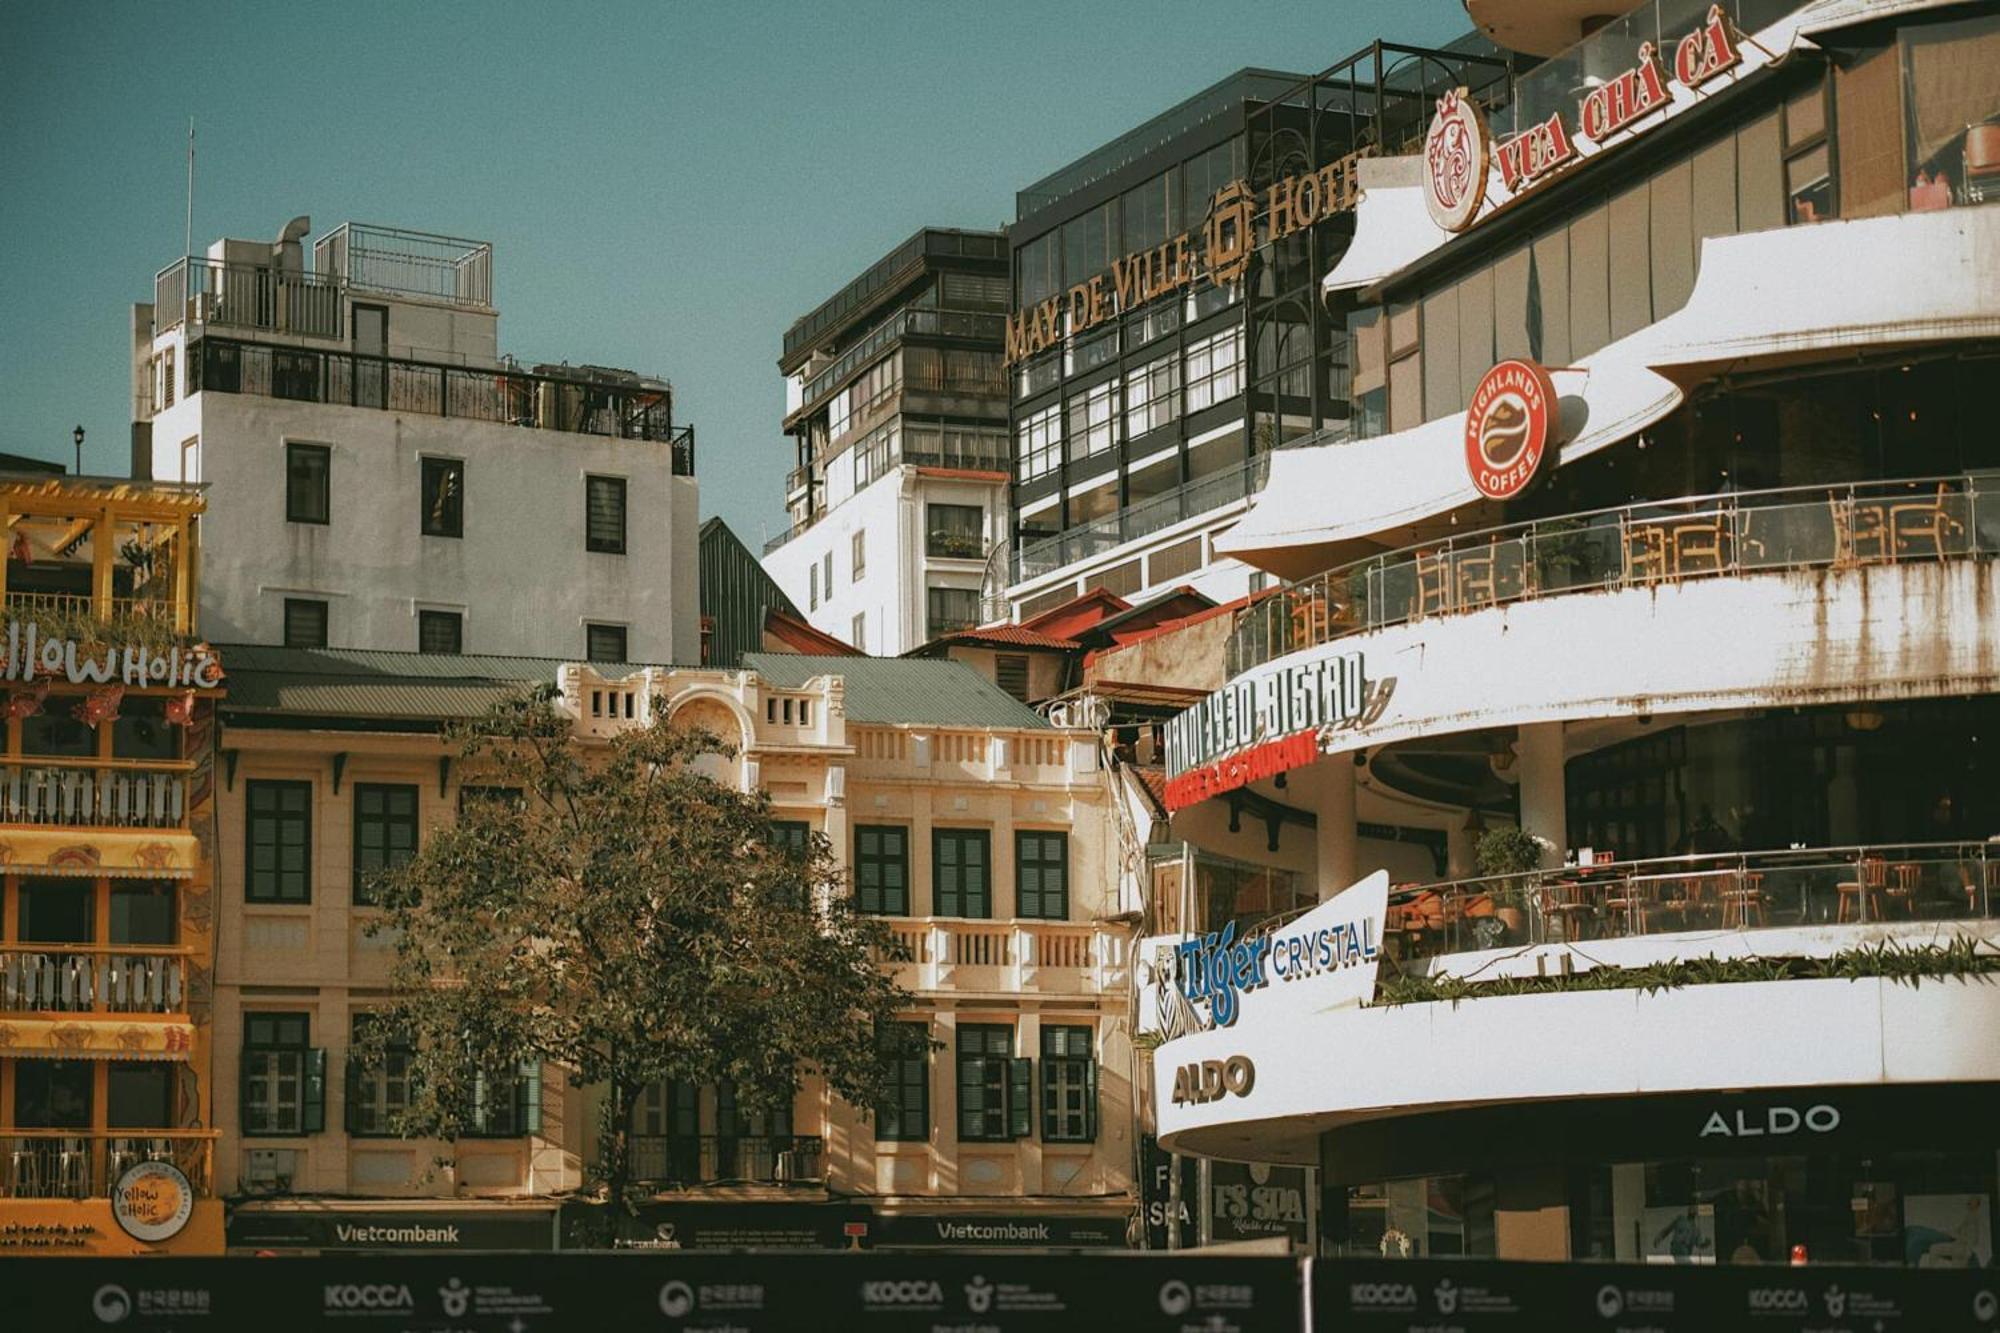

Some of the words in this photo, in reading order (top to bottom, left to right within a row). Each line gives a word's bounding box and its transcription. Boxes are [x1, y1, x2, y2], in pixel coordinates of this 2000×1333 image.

[1496, 112, 1570, 188] VUA
[1582, 41, 1666, 141] CHẢ
[1675, 4, 1735, 87] CÁ
[1004, 295, 1060, 366] MAY
[1069, 275, 1107, 333] DE
[1112, 233, 1192, 310] VILLE
[1267, 144, 1377, 241] HOTE
[1469, 370, 1541, 438] HIGHLANDS
[1480, 448, 1536, 491] COFFEE
[1206, 680, 1255, 757] 1930
[1262, 651, 1364, 738] BISTRO
[1181, 920, 1270, 1026] Tiger
[1272, 918, 1377, 977] CRYSTAL
[1172, 1055, 1255, 1105] ALDO
[1700, 1104, 1841, 1137] ALDO
[116, 1186, 159, 1203] Yellow
[1213, 1184, 1249, 1219] FS
[1250, 1184, 1306, 1223] SPA
[337, 1223, 459, 1242] Vietcombank
[937, 1222, 1049, 1240] Vietcombank
[324, 1284, 414, 1307] KOCCA
[863, 1280, 944, 1302] KOCCA
[1351, 1284, 1417, 1304] KOCCA
[1748, 1289, 1808, 1308] KOCCA
